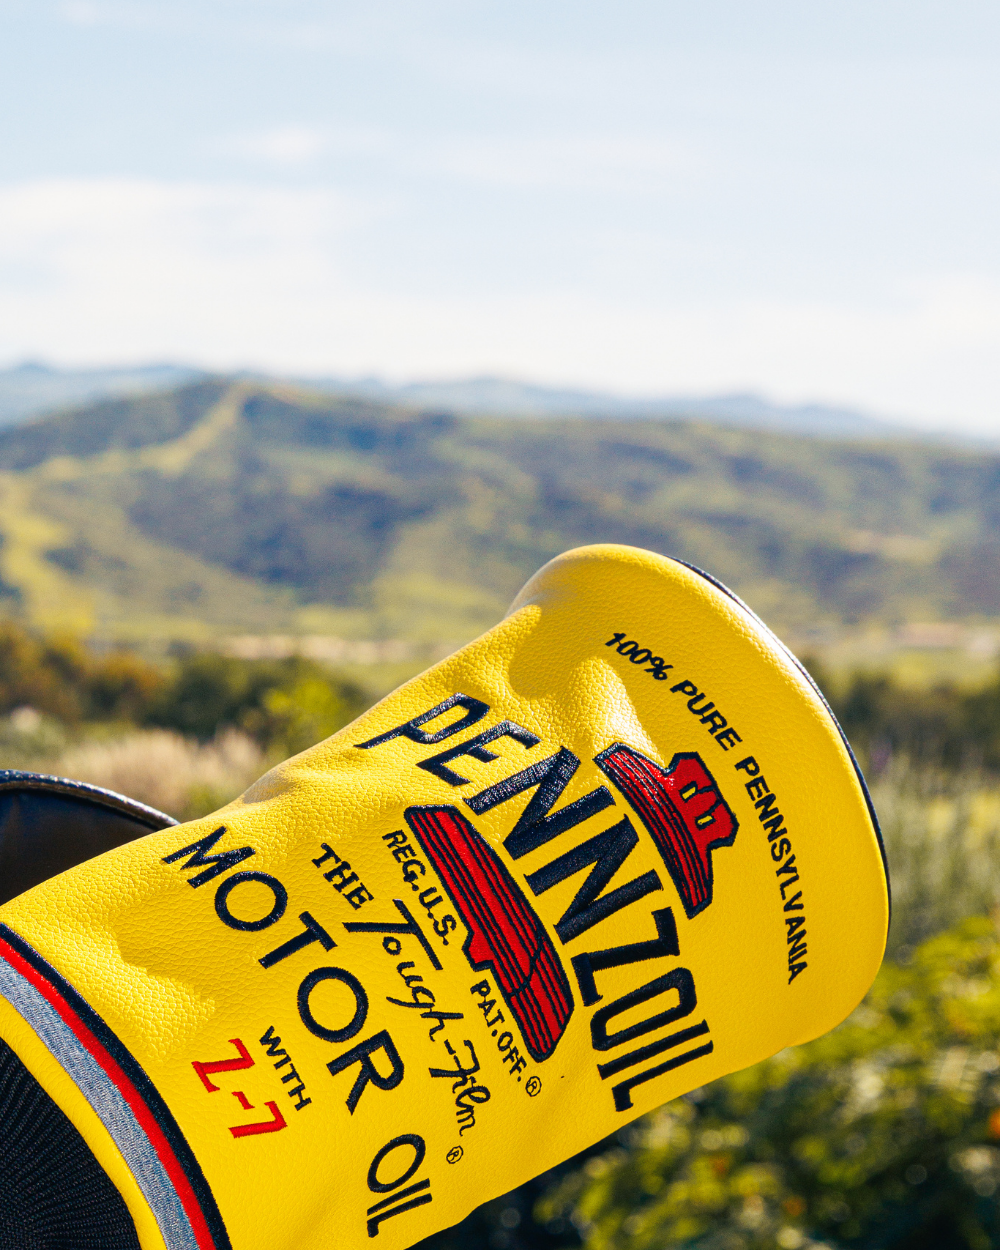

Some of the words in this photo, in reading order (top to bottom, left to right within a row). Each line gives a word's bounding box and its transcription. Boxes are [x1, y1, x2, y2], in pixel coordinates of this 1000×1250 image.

[311, 843, 375, 910] THE
[354, 692, 714, 1111] PENNZOIL
[605, 632, 673, 680] 100%
[670, 680, 743, 751] PURE
[735, 756, 808, 985] PENNSYLVANIA
[161, 826, 402, 1114] MOTOR
[366, 1133, 432, 1237] OIL
[191, 1037, 288, 1139] Z-7
[259, 1025, 312, 1111] WITH
